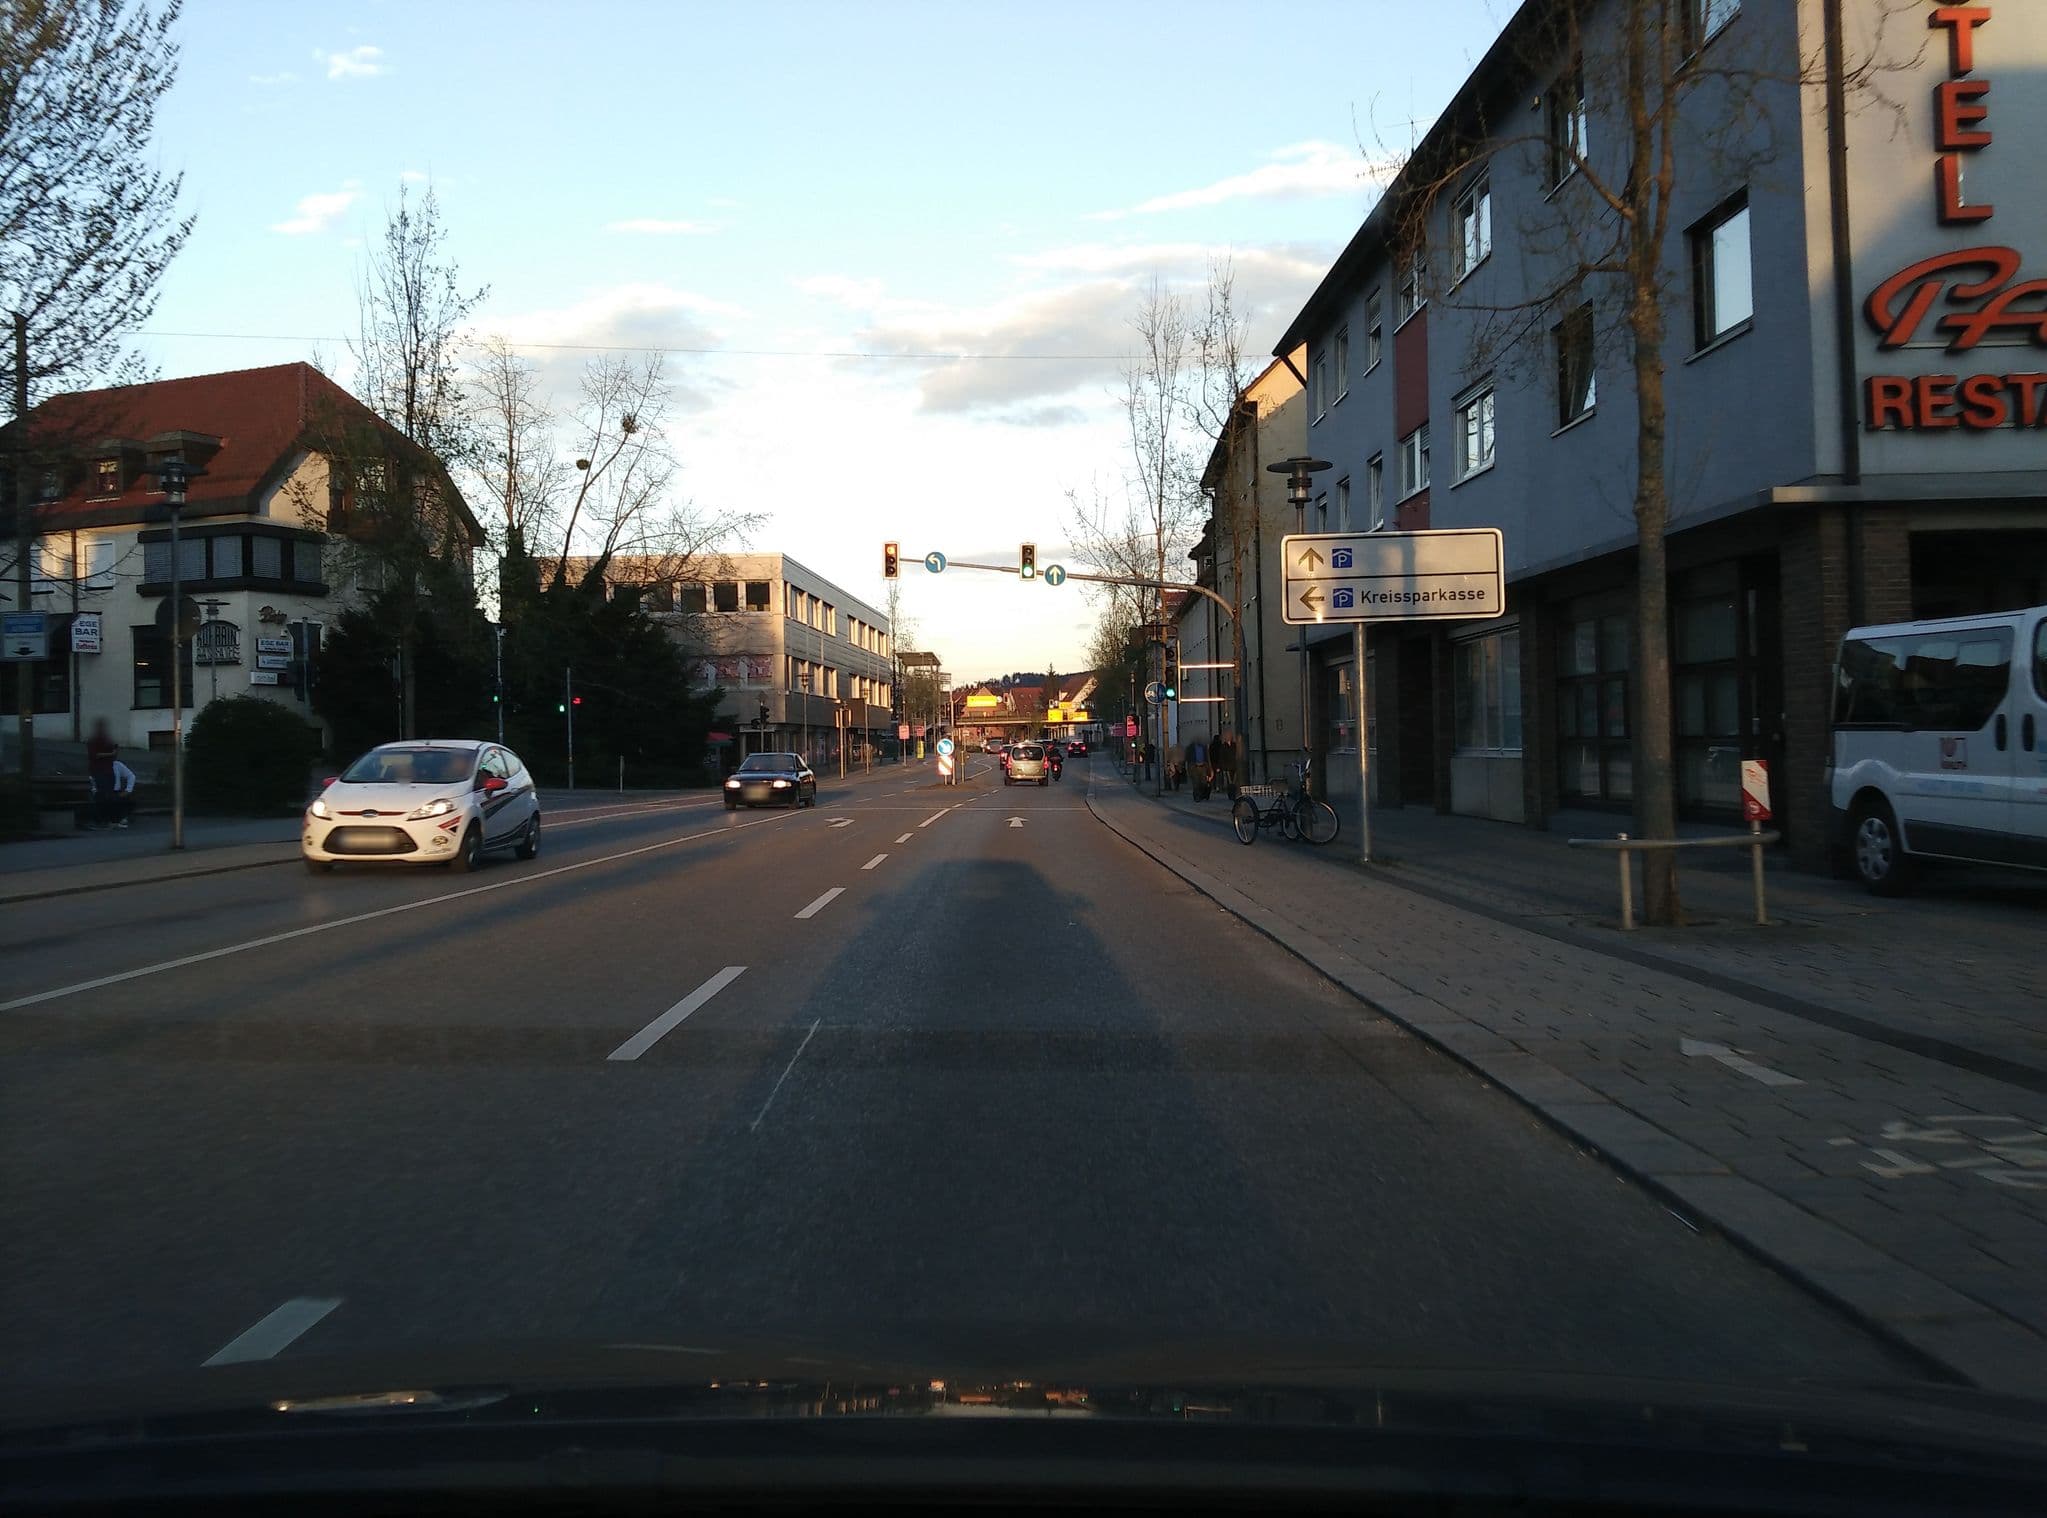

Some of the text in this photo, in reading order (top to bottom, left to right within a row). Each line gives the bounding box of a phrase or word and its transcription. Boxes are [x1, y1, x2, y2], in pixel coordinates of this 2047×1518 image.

[1928, 0, 1993, 225] TEL
[1864, 371, 2047, 431] REST
[1361, 588, 1485, 605] Kreissparkasse
[75, 628, 97, 636] BAR
